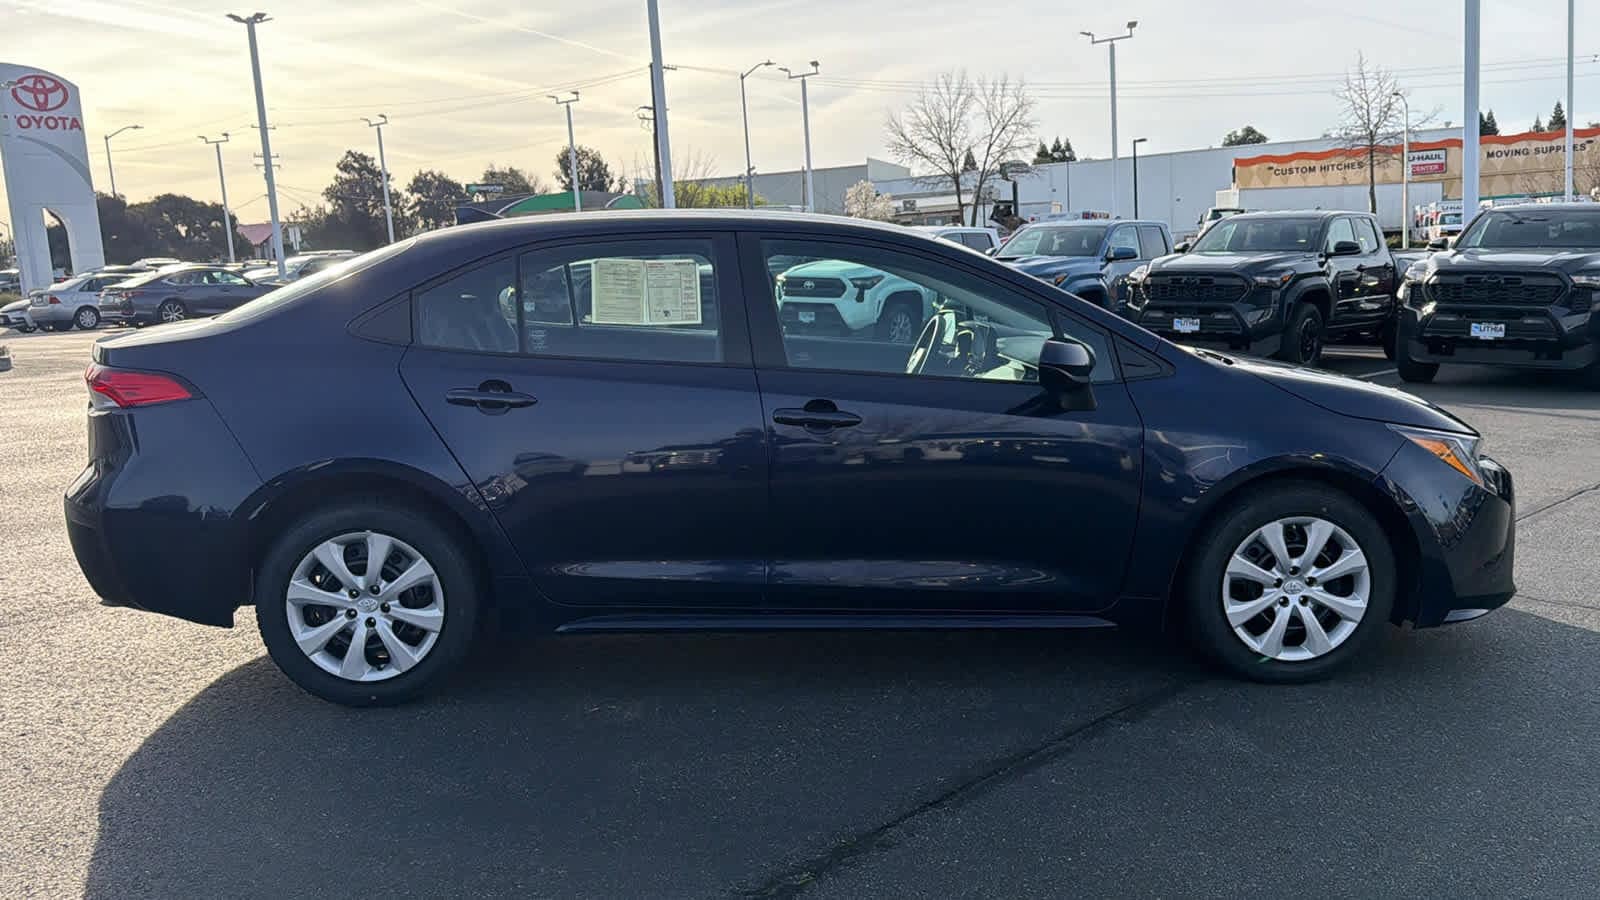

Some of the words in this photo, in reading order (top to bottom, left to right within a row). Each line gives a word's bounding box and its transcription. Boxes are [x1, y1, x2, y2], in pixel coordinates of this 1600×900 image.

[4, 114, 82, 130] OYOTA
[1486, 148, 1529, 159] MOVING
[1534, 143, 1586, 155] SUPPLES
[1273, 165, 1316, 177] CUSTOM
[1319, 161, 1364, 172] HITCHES
